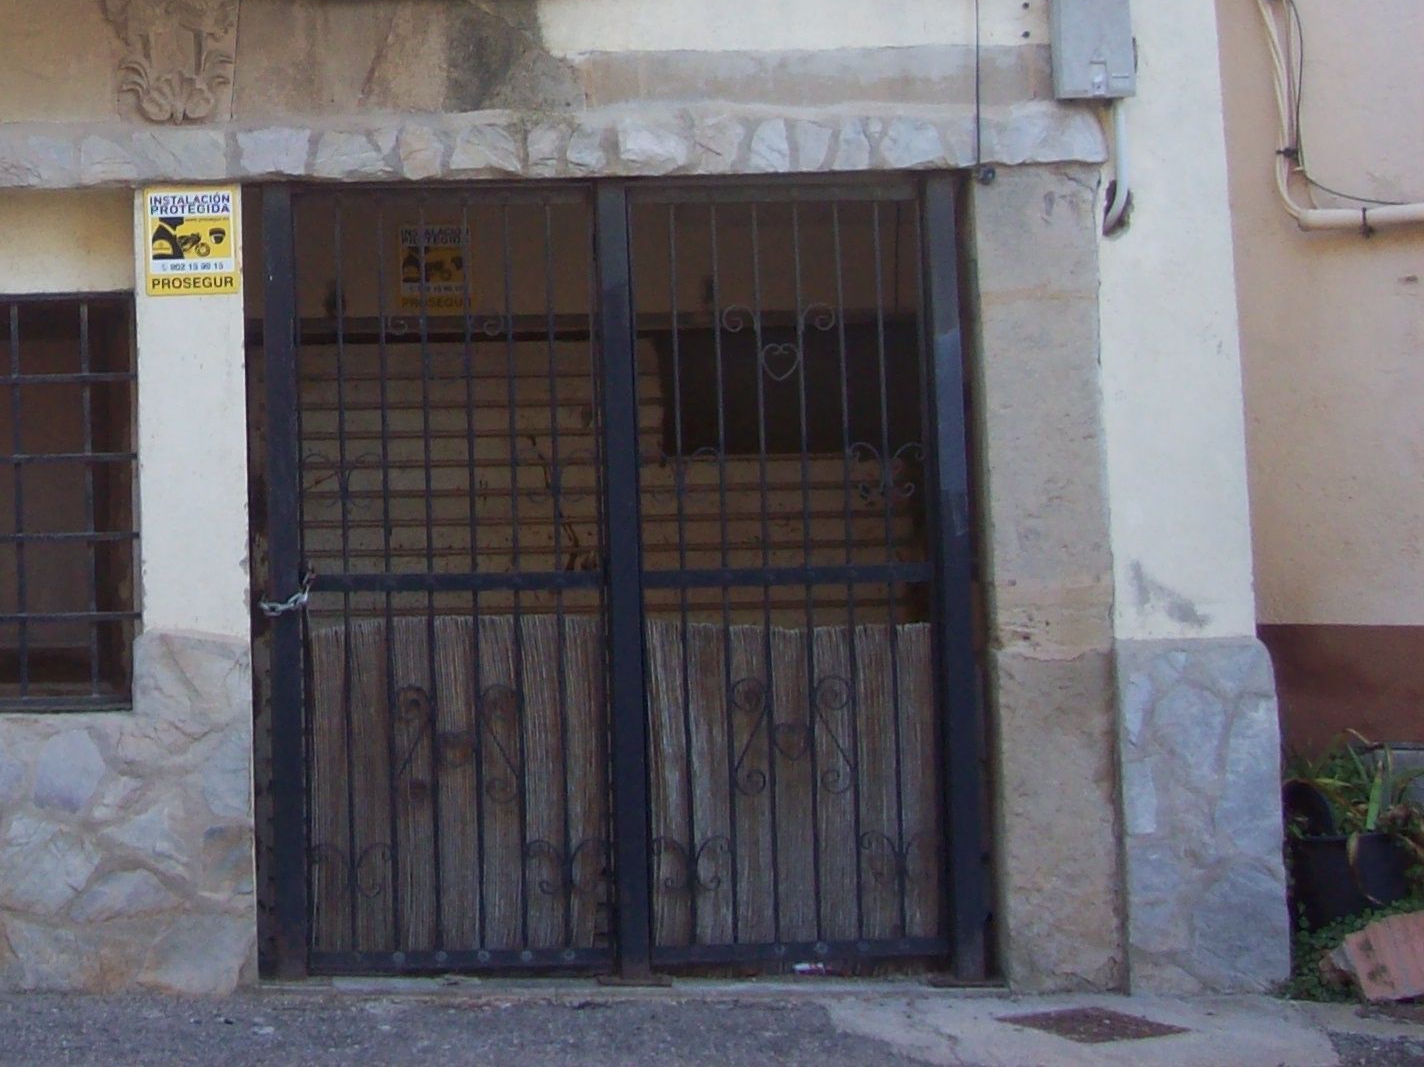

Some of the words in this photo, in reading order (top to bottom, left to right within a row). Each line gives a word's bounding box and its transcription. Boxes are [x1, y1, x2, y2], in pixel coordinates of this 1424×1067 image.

[150, 204, 231, 215] PROTEGIDA
[401, 236, 469, 245] PRTEGID
[151, 276, 234, 290] PROSEGUR
